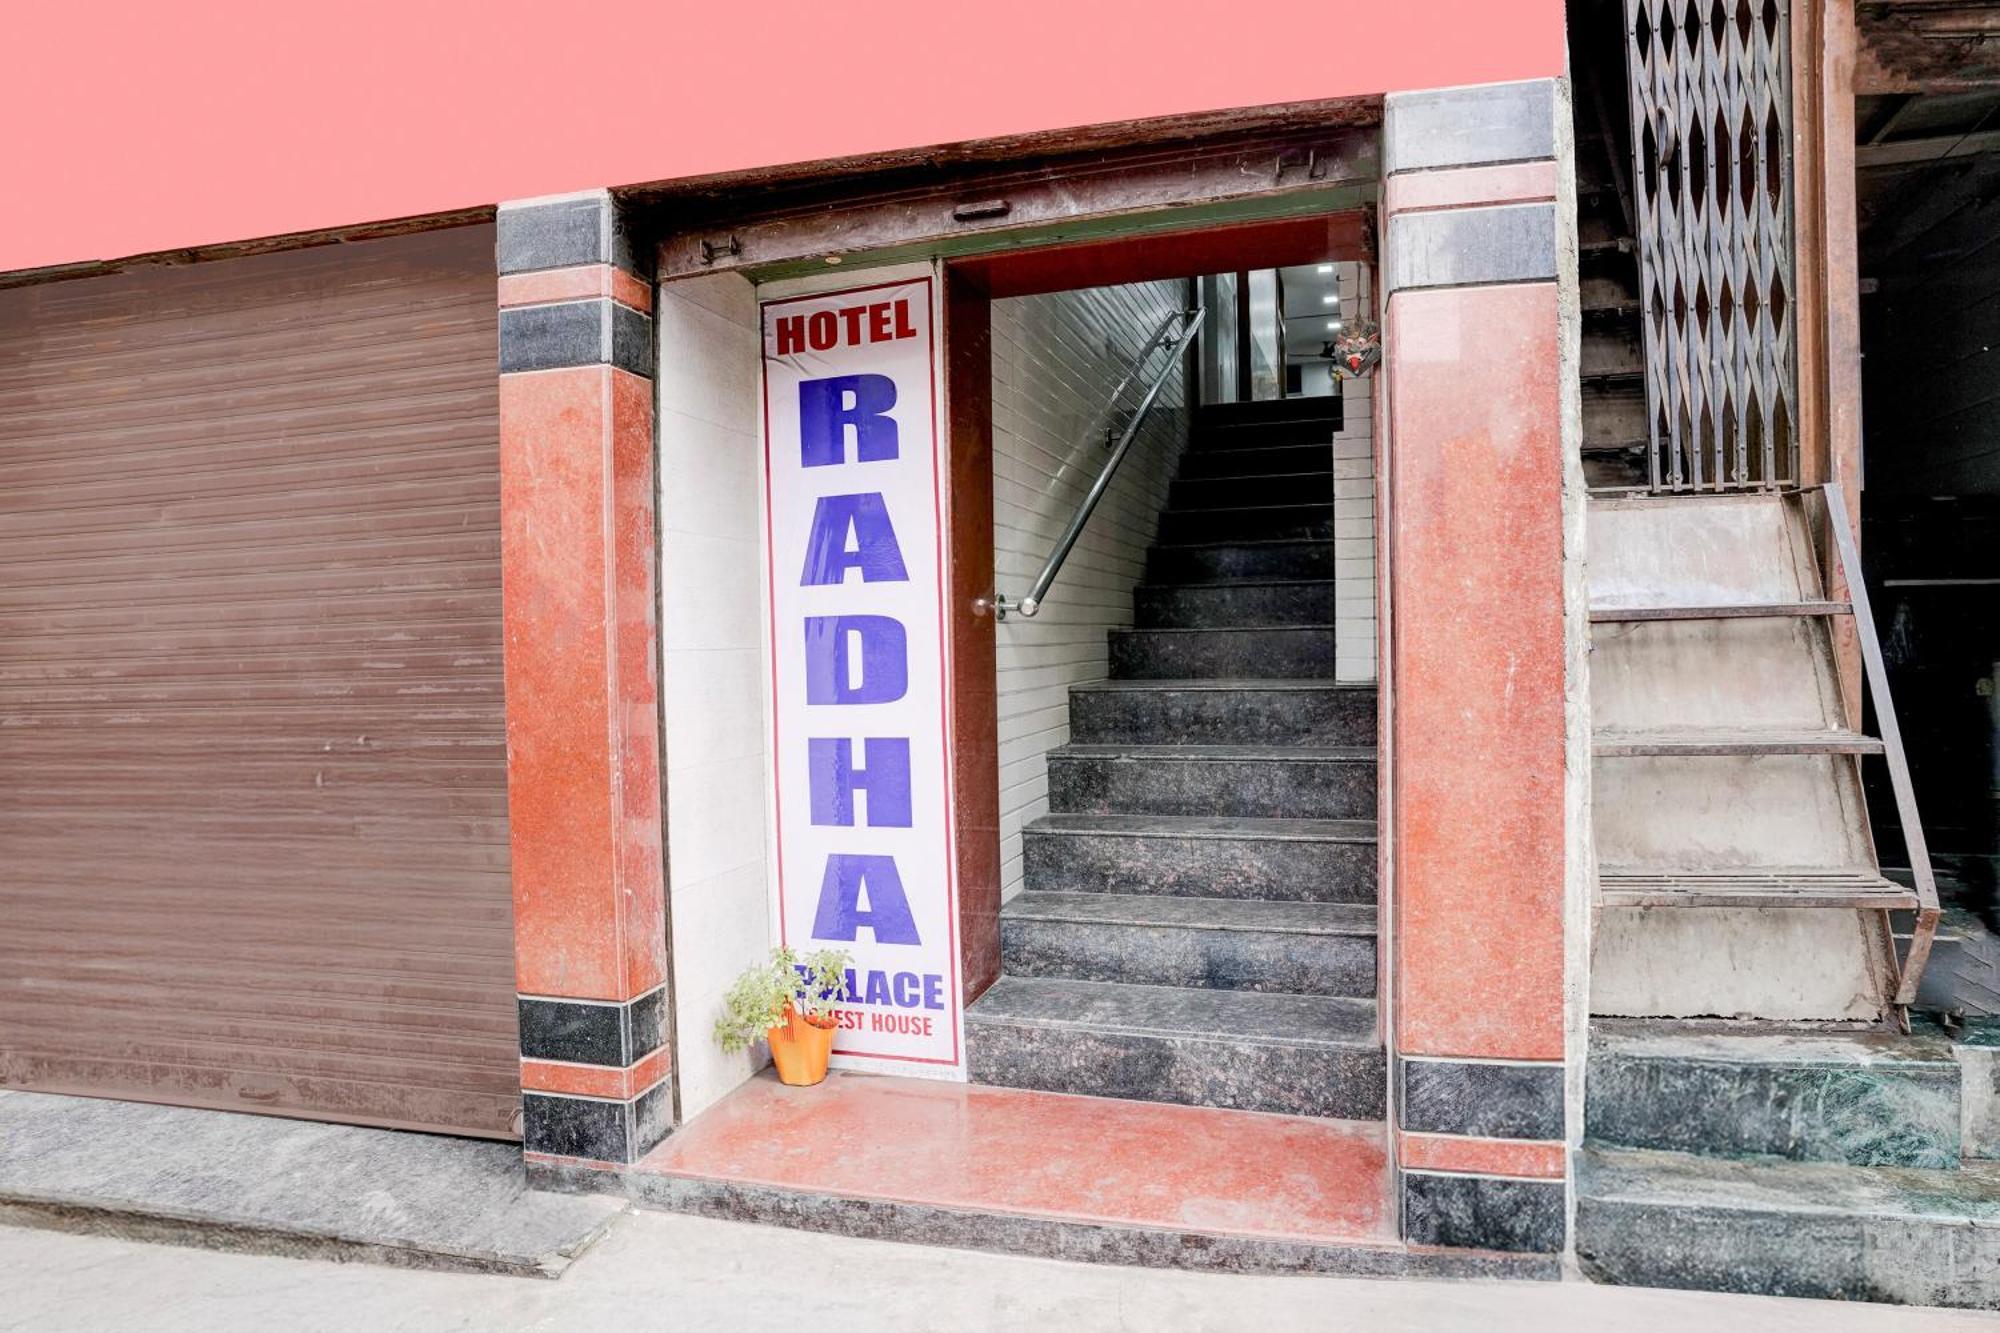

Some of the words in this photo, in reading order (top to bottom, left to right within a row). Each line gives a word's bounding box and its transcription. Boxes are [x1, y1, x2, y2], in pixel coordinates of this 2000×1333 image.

[776, 299, 917, 355] HOTEL
[799, 373, 922, 946] RADHA
[809, 1006, 865, 1031] EST
[872, 1012, 933, 1037] HOUSE
